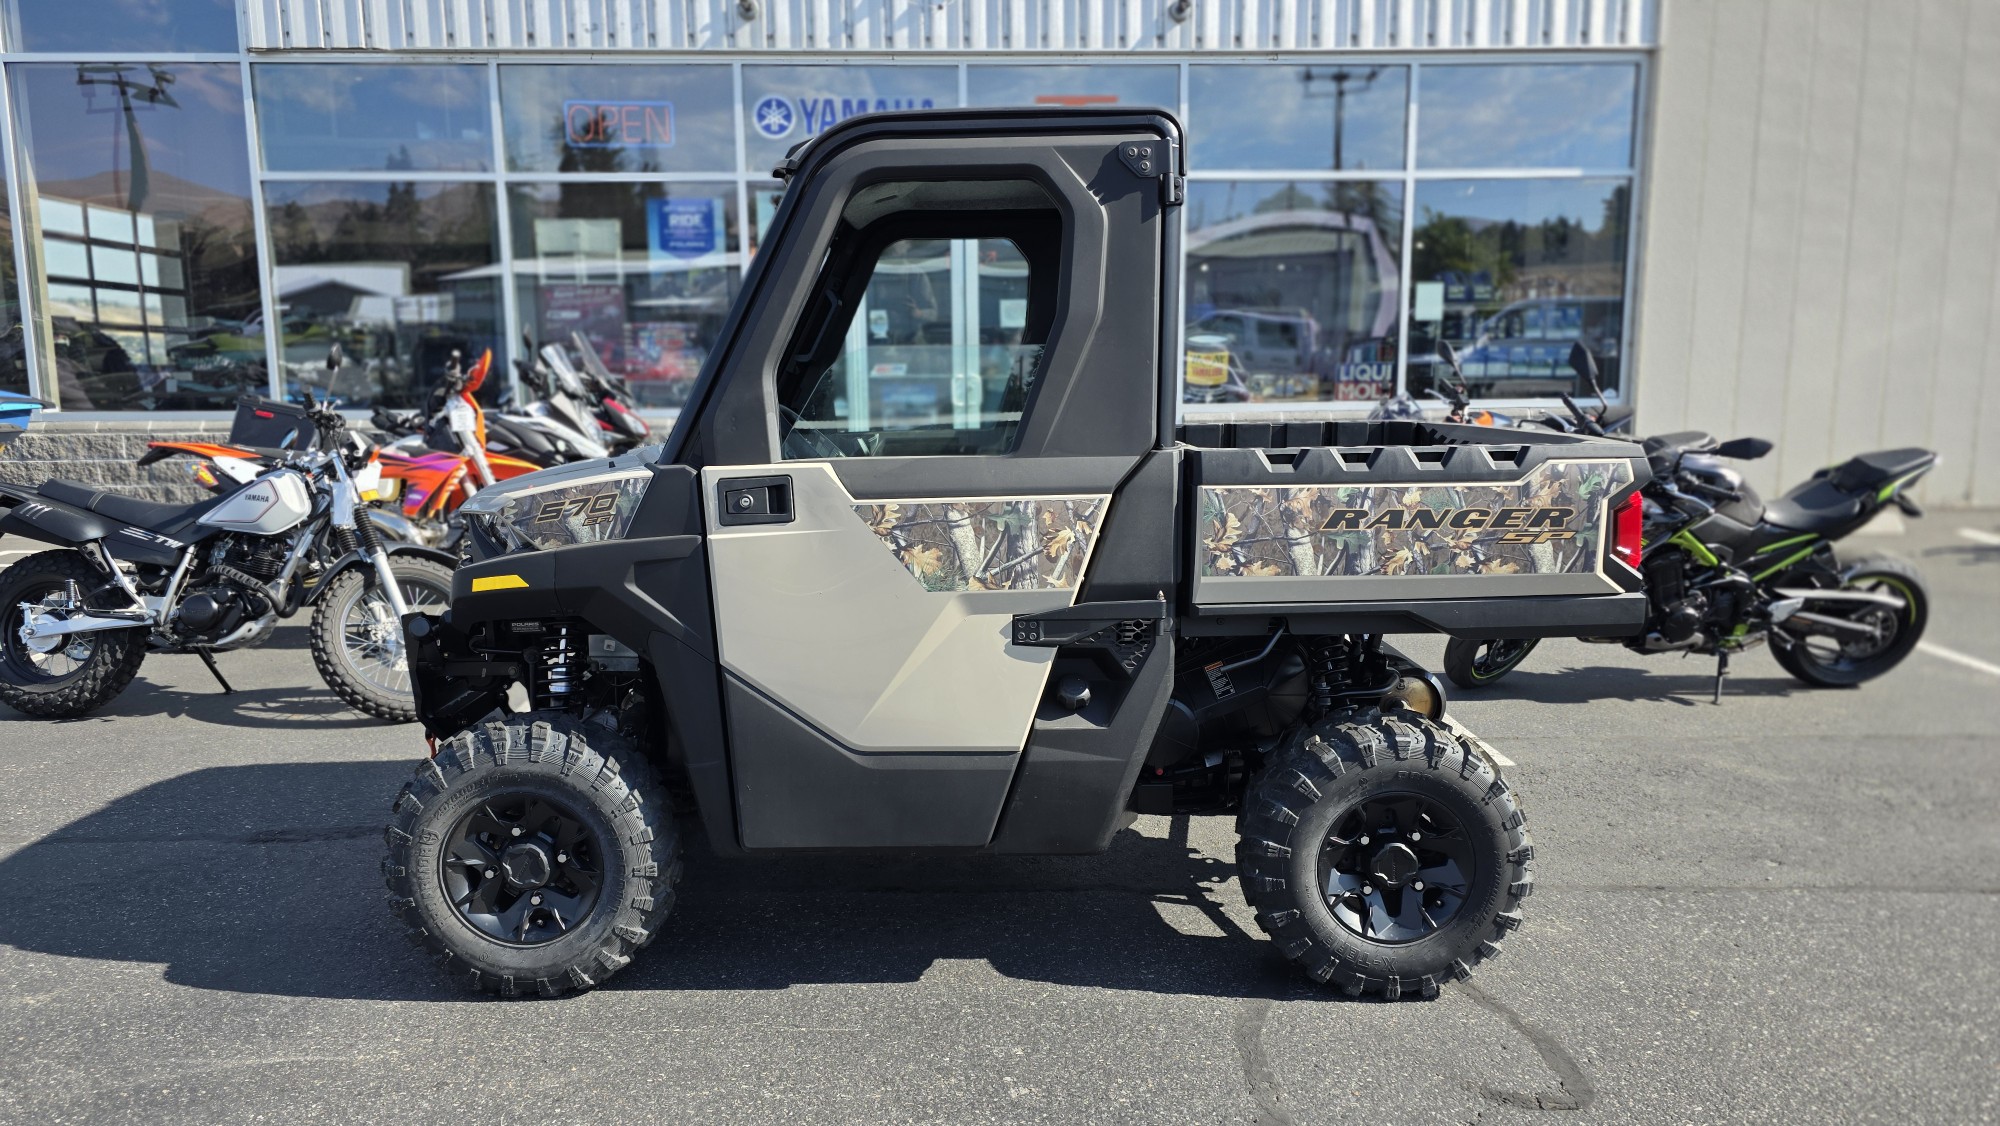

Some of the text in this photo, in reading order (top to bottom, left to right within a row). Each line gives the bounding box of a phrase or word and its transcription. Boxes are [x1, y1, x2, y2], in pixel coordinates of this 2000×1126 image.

[567, 104, 673, 143] OPEN
[799, 98, 934, 135] YAM
[1340, 364, 1392, 381] LIQUI
[244, 494, 270, 503] YAMAHA
[535, 492, 619, 524] 570
[582, 513, 616, 527] EFI
[1319, 506, 1576, 532] RANGER
[154, 534, 184, 548] TW
[1497, 530, 1578, 545] SP
